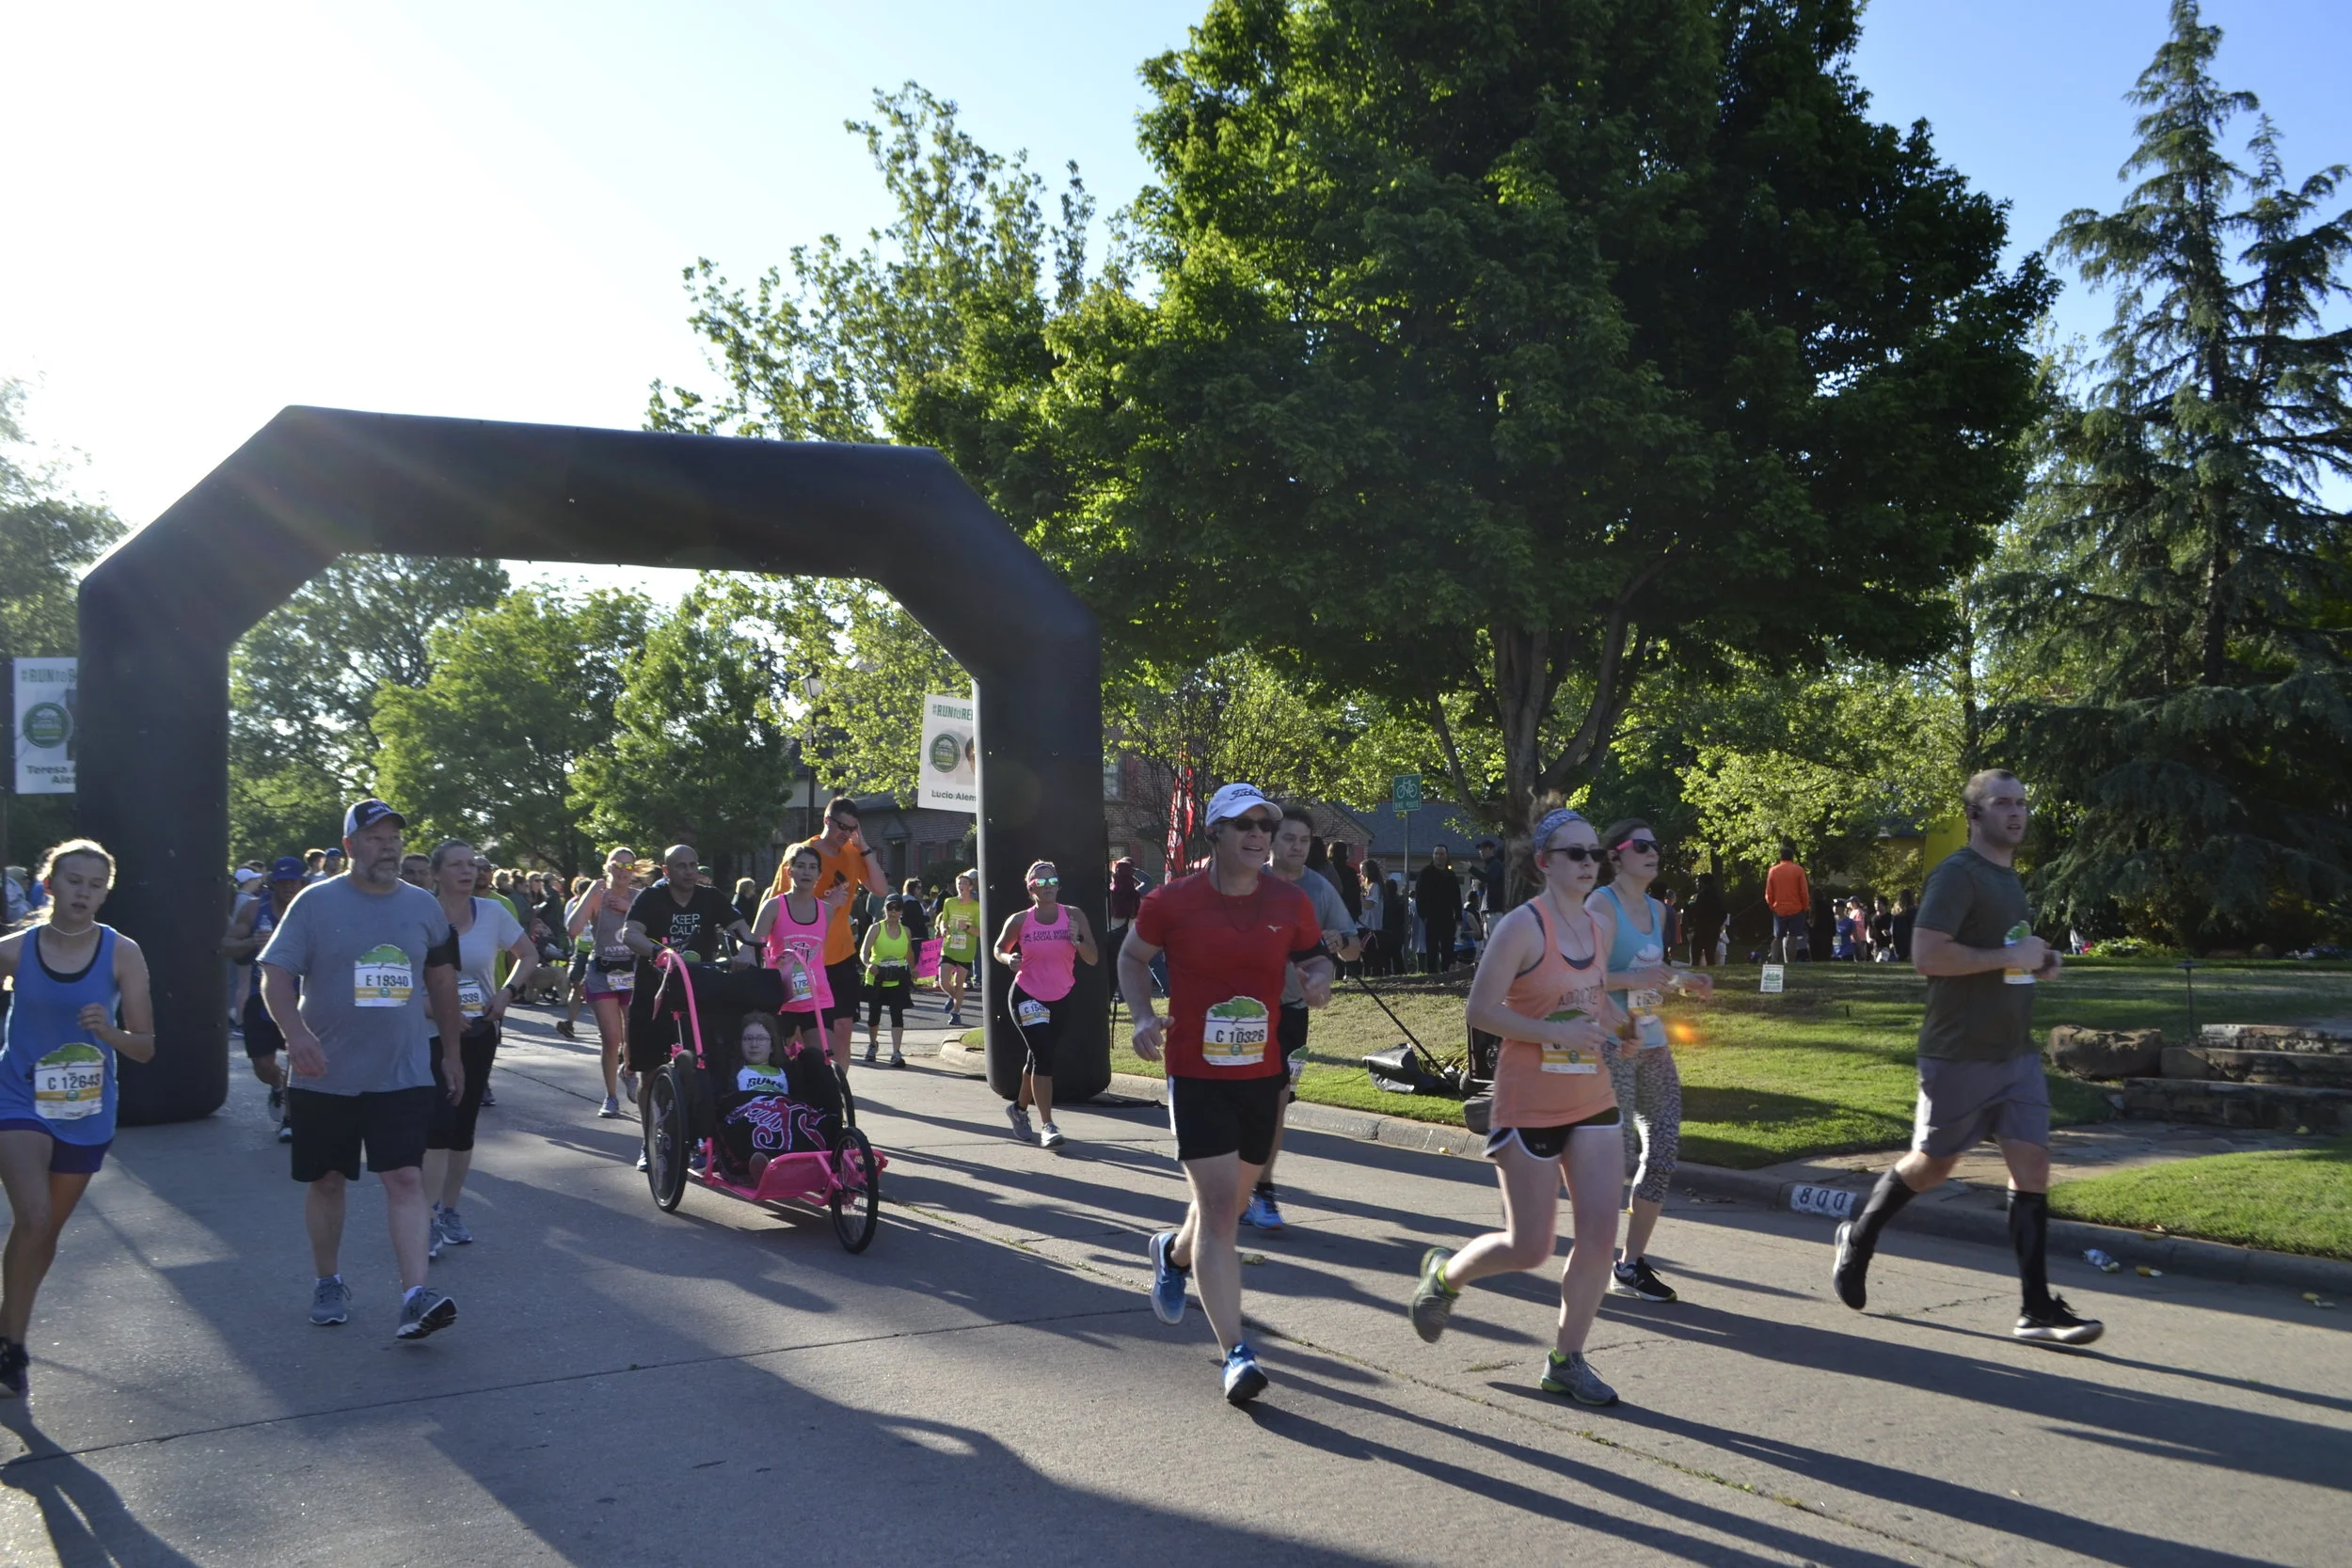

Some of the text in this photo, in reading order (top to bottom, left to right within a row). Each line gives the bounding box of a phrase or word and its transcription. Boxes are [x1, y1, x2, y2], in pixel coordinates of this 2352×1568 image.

[932, 704, 975, 721] #RUNtoRE
[25, 765, 69, 774] Teresa
[931, 789, 954, 800] Lucio
[672, 913, 701, 925] KEEP
[366, 974, 409, 988] E 19340
[1216, 1029, 1265, 1044] C 10326
[48, 1072, 101, 1090] C 12643
[1799, 1187, 1848, 1211] 800
